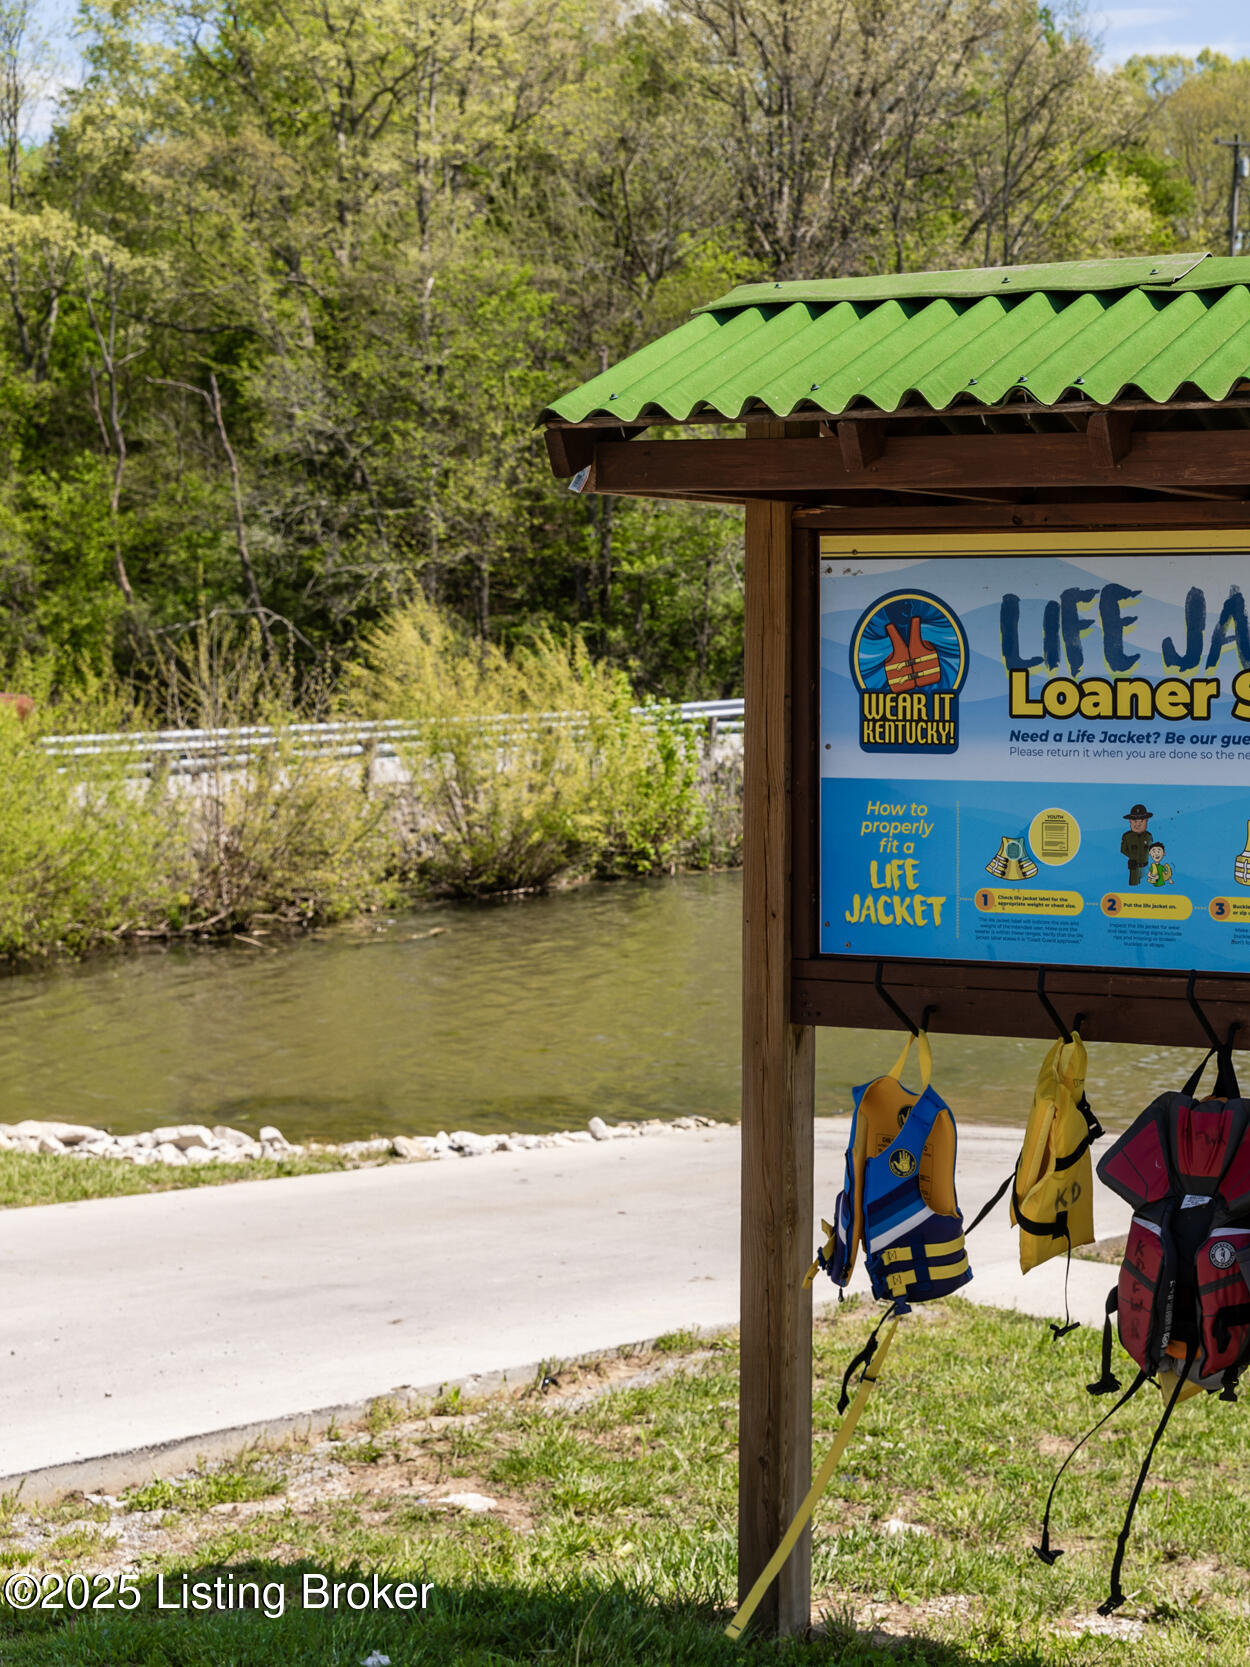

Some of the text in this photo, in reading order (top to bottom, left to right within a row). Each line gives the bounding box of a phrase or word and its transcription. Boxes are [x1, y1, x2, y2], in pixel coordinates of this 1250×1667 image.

[1000, 583, 1143, 678] LIFE
[1010, 669, 1220, 720] Loaner
[863, 693, 955, 721] WEAR IT
[863, 721, 955, 744] KENTUCKY!
[1009, 729, 1049, 742] Need
[1053, 732, 1063, 742] a
[1067, 730, 1095, 743] Life
[1099, 731, 1160, 743] Jacket?
[1164, 732, 1185, 744] Be
[1190, 735, 1217, 744] our
[1009, 747, 1044, 757] Please
[1046, 747, 1080, 757] return
[1082, 748, 1090, 758] it
[1092, 748, 1123, 758] when
[1125, 751, 1146, 761] you
[1149, 751, 1166, 759] are
[1168, 749, 1198, 759] done
[1215, 750, 1234, 760] the
[866, 801, 928, 816] How to
[861, 819, 934, 838] properly
[879, 837, 915, 854] fit a
[870, 858, 920, 891] LIFE
[981, 893, 989, 906] 1
[1107, 898, 1117, 911] 2
[845, 893, 946, 927] JACKET
[1215, 902, 1225, 916] 3
